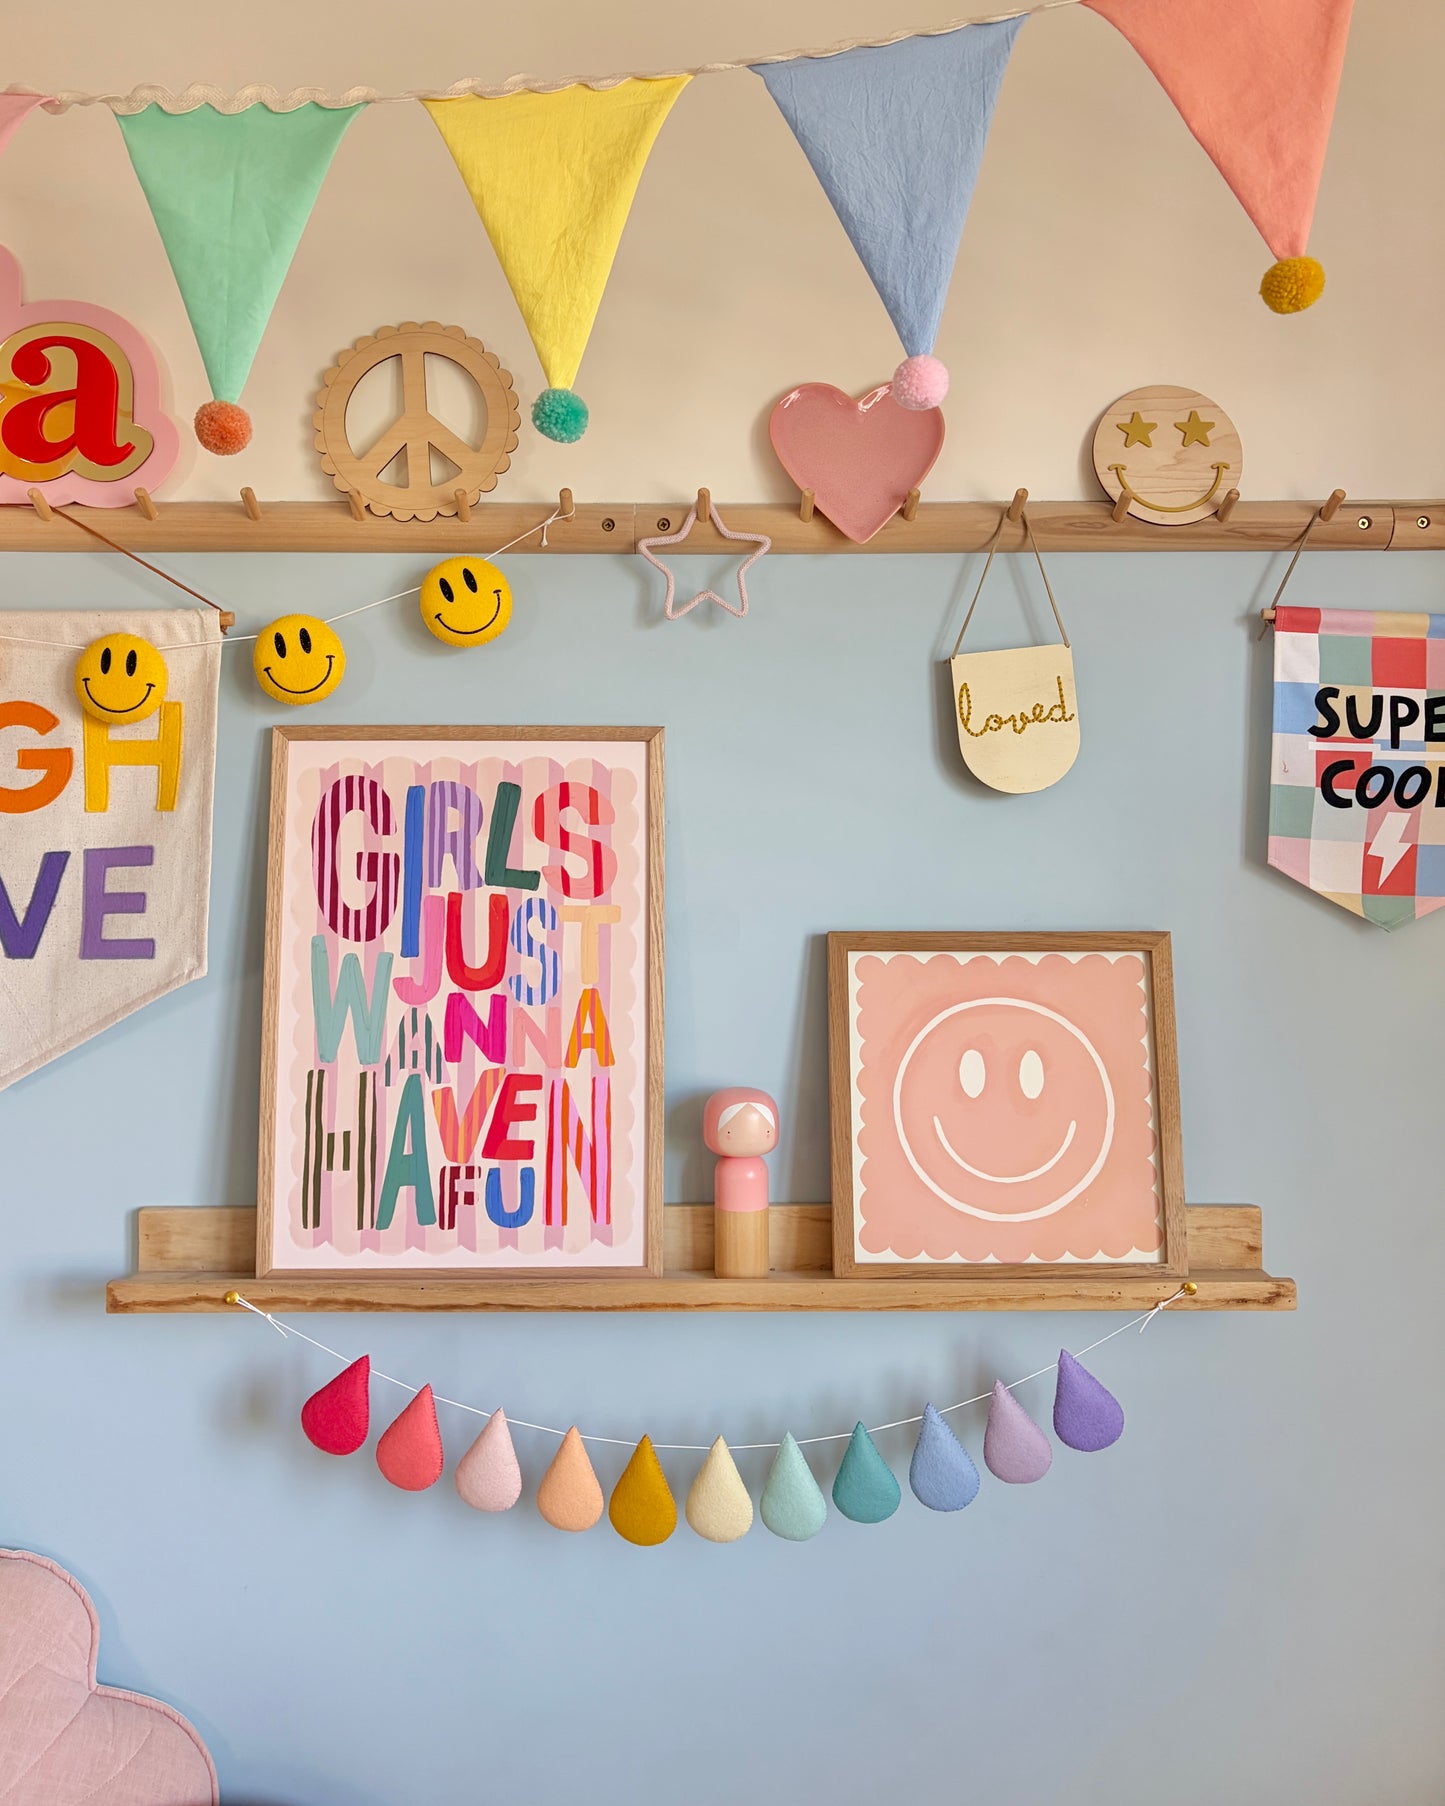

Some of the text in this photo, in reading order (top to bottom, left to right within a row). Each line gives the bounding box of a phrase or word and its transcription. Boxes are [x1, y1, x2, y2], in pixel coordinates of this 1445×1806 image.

[958, 675, 1075, 738] loved
[311, 775, 618, 958] GIRLS
[311, 935, 615, 1087] WANNA
[393, 892, 622, 1006] JUST
[302, 1068, 543, 1231] HAVE
[439, 1077, 612, 1230] FUN
